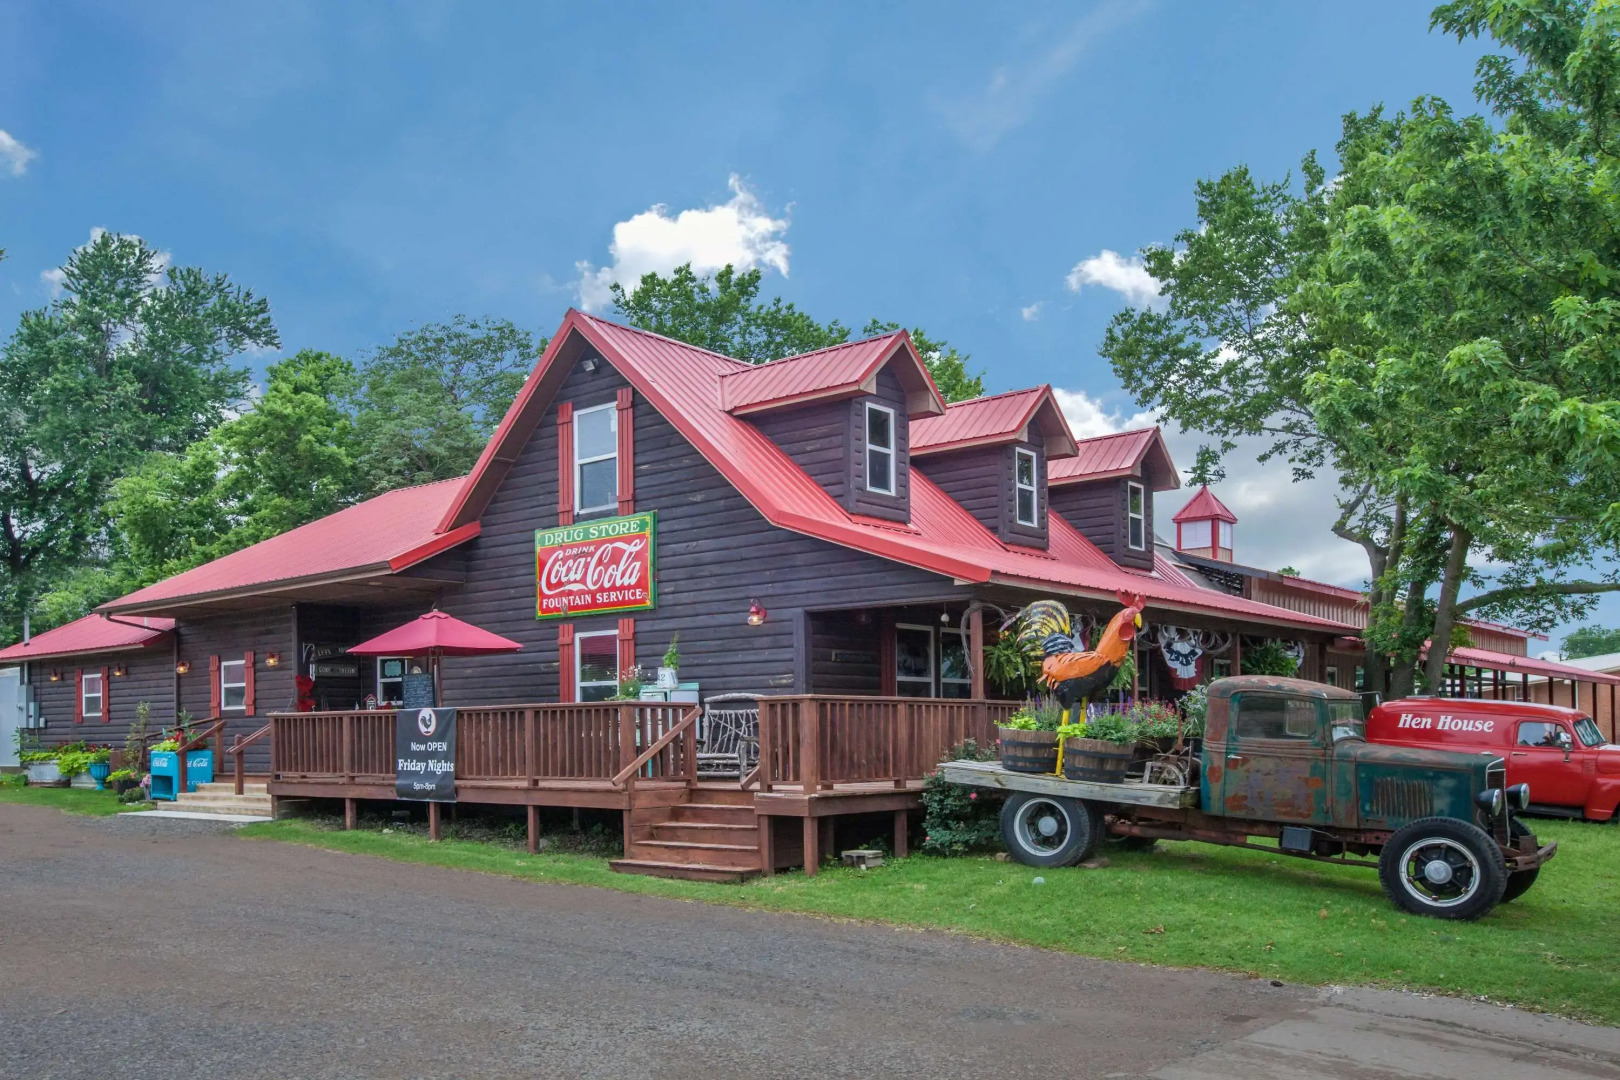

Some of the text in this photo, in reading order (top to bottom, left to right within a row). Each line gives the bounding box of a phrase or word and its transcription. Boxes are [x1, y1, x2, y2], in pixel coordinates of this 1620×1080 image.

[545, 520, 640, 545] DRUG STORE
[565, 545, 595, 556] DRINK
[541, 538, 646, 594] Coca-Cola
[542, 588, 643, 609] FOUNTAIN SERVICE
[1397, 713, 1495, 733] Hen House
[411, 742, 447, 751] Now OPEN
[398, 759, 454, 774] Friday Nights
[413, 782, 436, 791] 5pm-8pm
